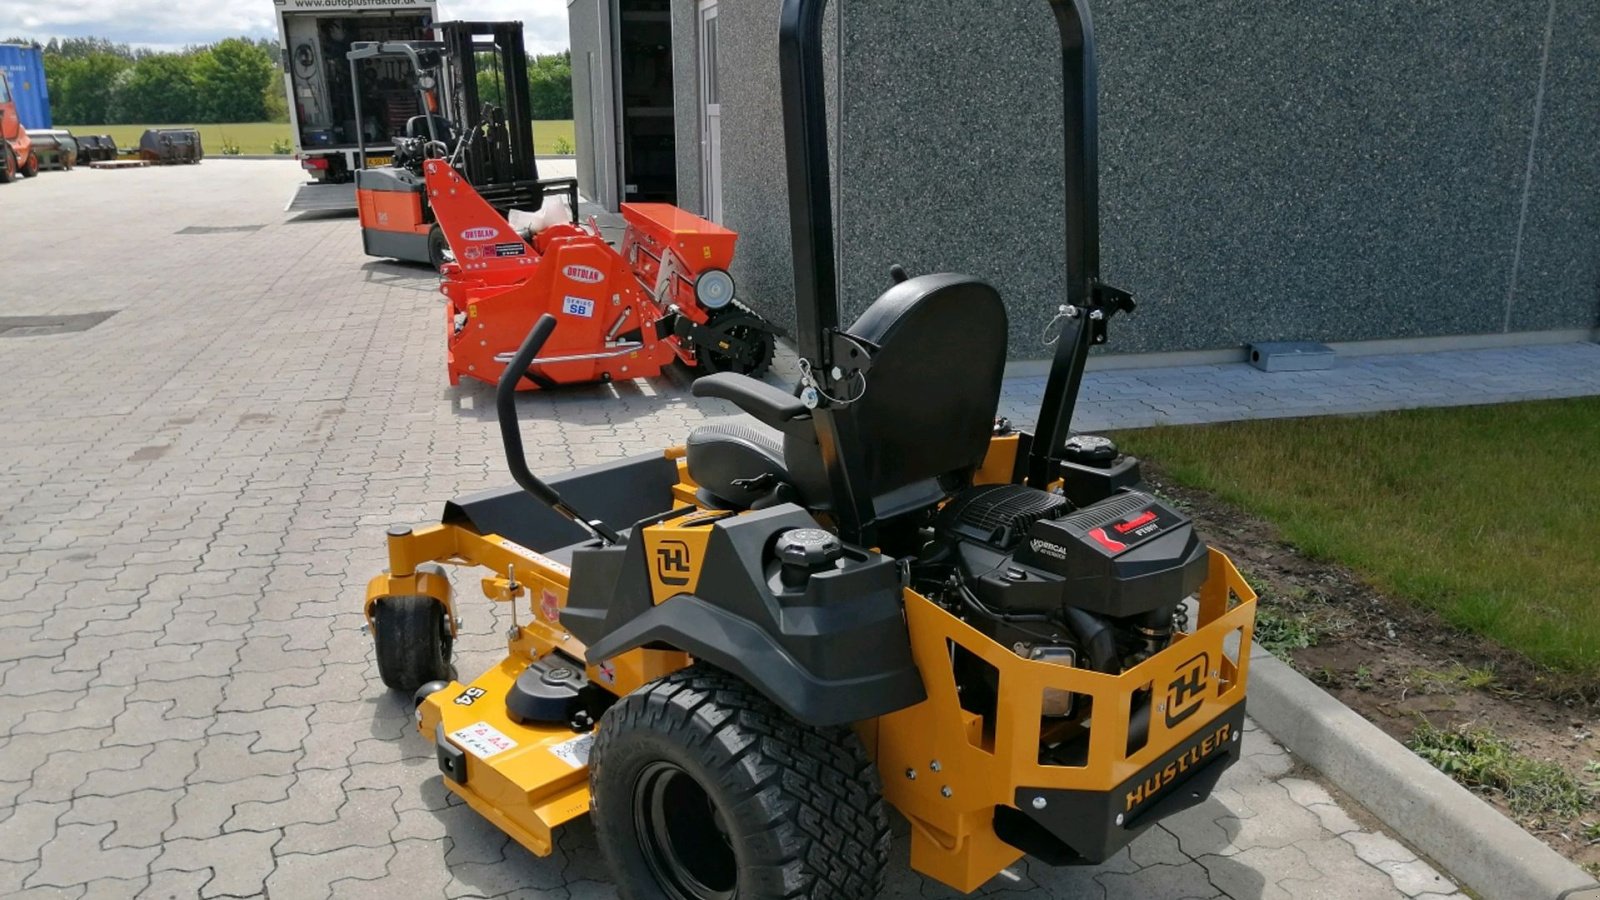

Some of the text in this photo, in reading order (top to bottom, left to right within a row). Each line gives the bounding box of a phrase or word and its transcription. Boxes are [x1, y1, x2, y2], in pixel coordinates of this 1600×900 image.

[464, 229, 494, 238] ORTOLAN
[567, 268, 599, 281] ORTOLAN
[569, 303, 586, 315] SB
[454, 687, 487, 706] 54
[1125, 723, 1232, 812] HUSTLER
